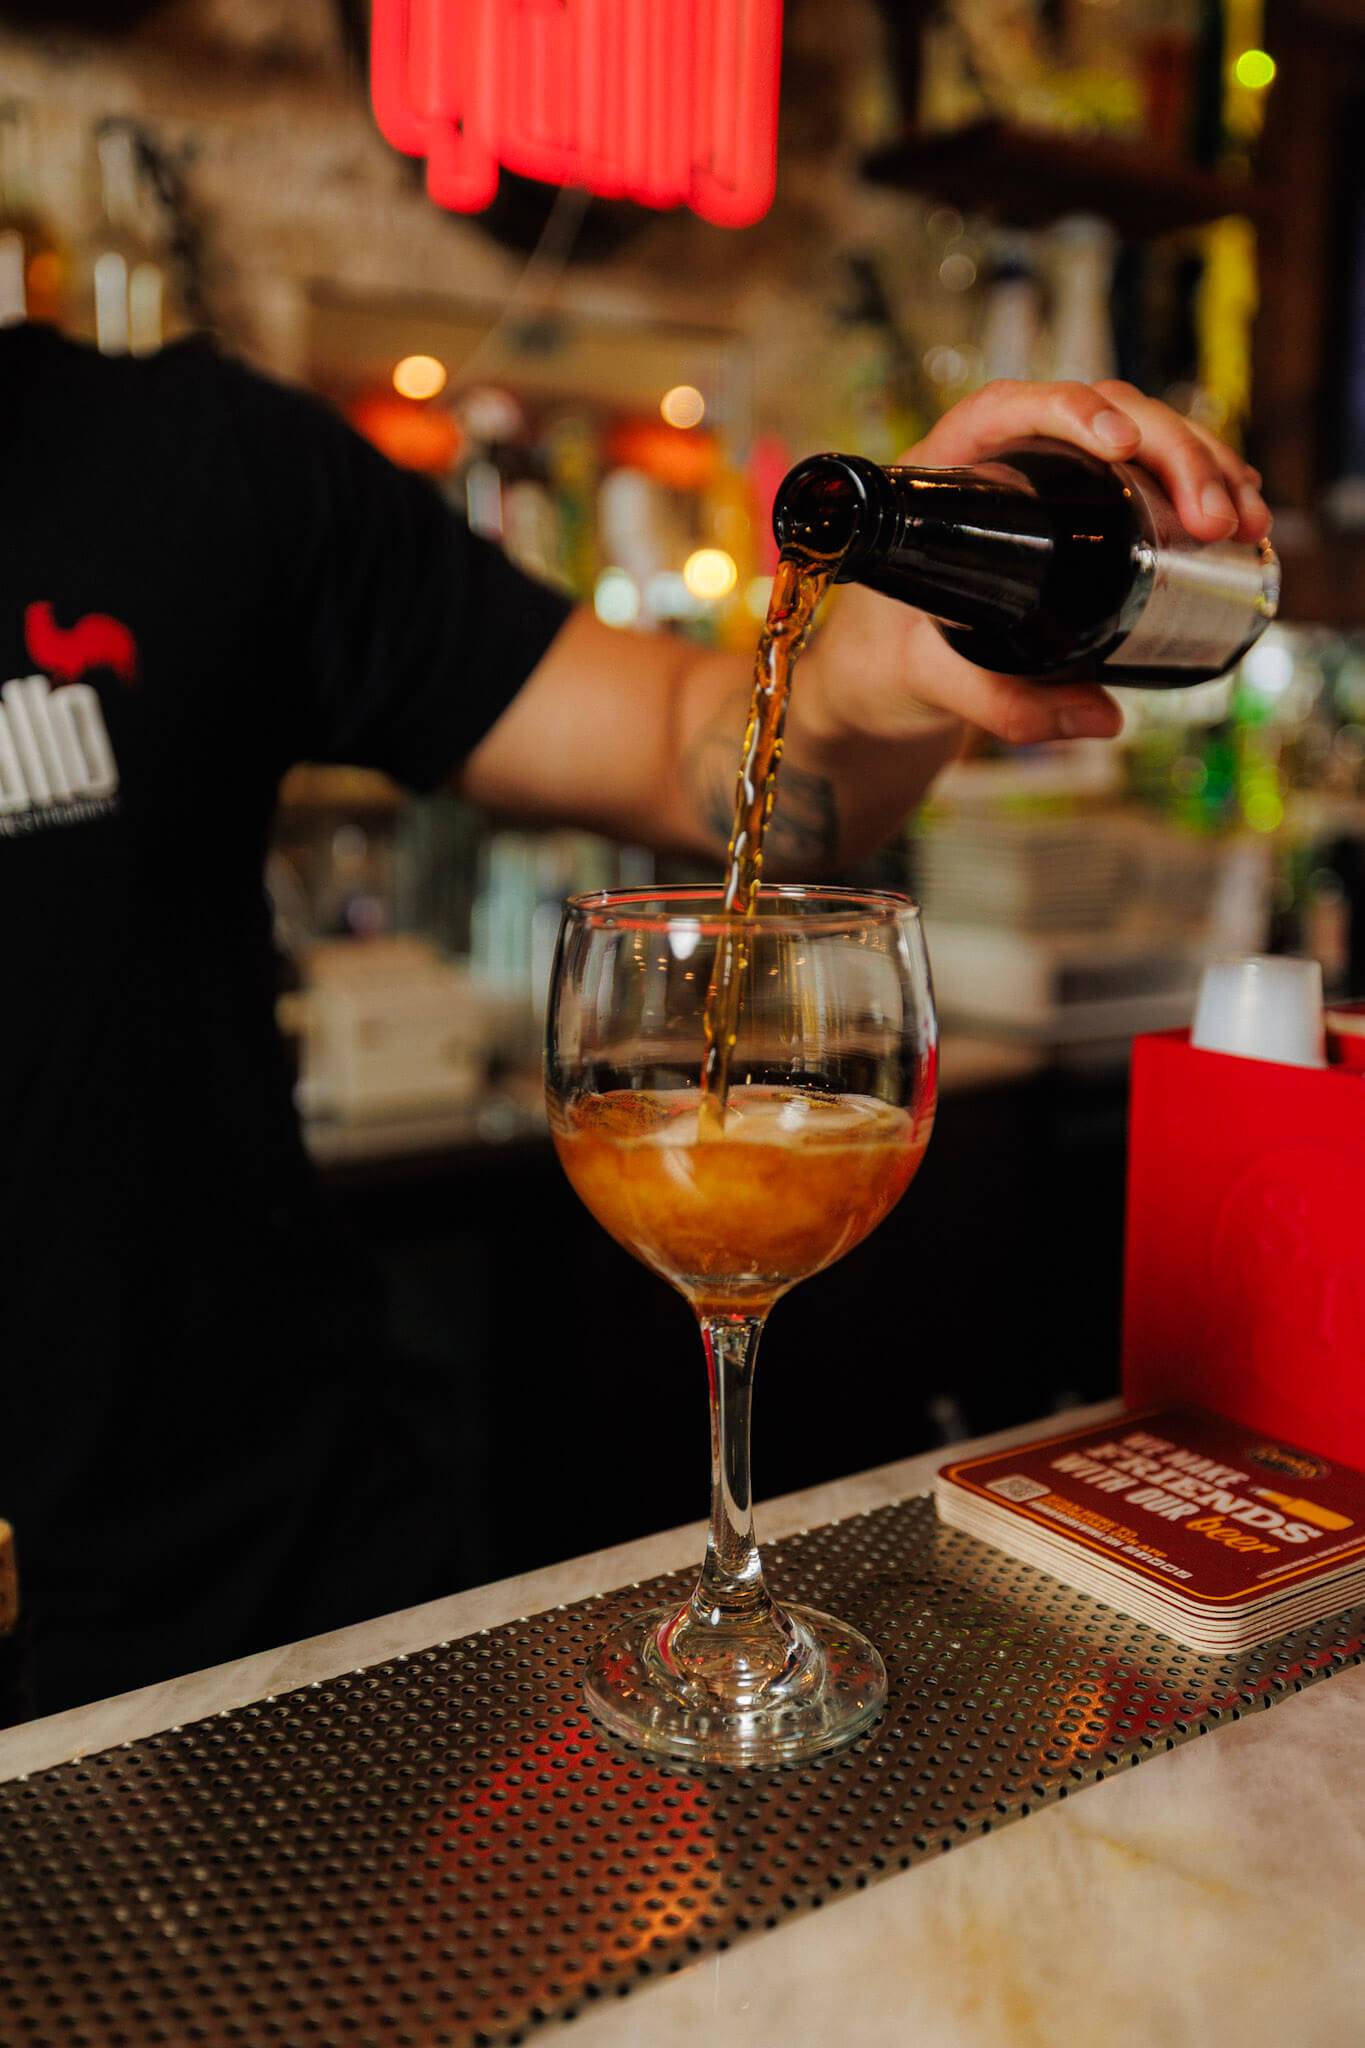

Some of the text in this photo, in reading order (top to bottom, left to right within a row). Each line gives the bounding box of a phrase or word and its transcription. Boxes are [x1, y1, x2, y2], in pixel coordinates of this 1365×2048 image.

[1050, 1453, 1140, 1493] WITH
[1125, 1487, 1201, 1521] OUR
[1185, 1515, 1281, 1554] beer
[1082, 1442, 1325, 1544] FRIENDS
[1160, 1450, 1250, 1488] MAKE
